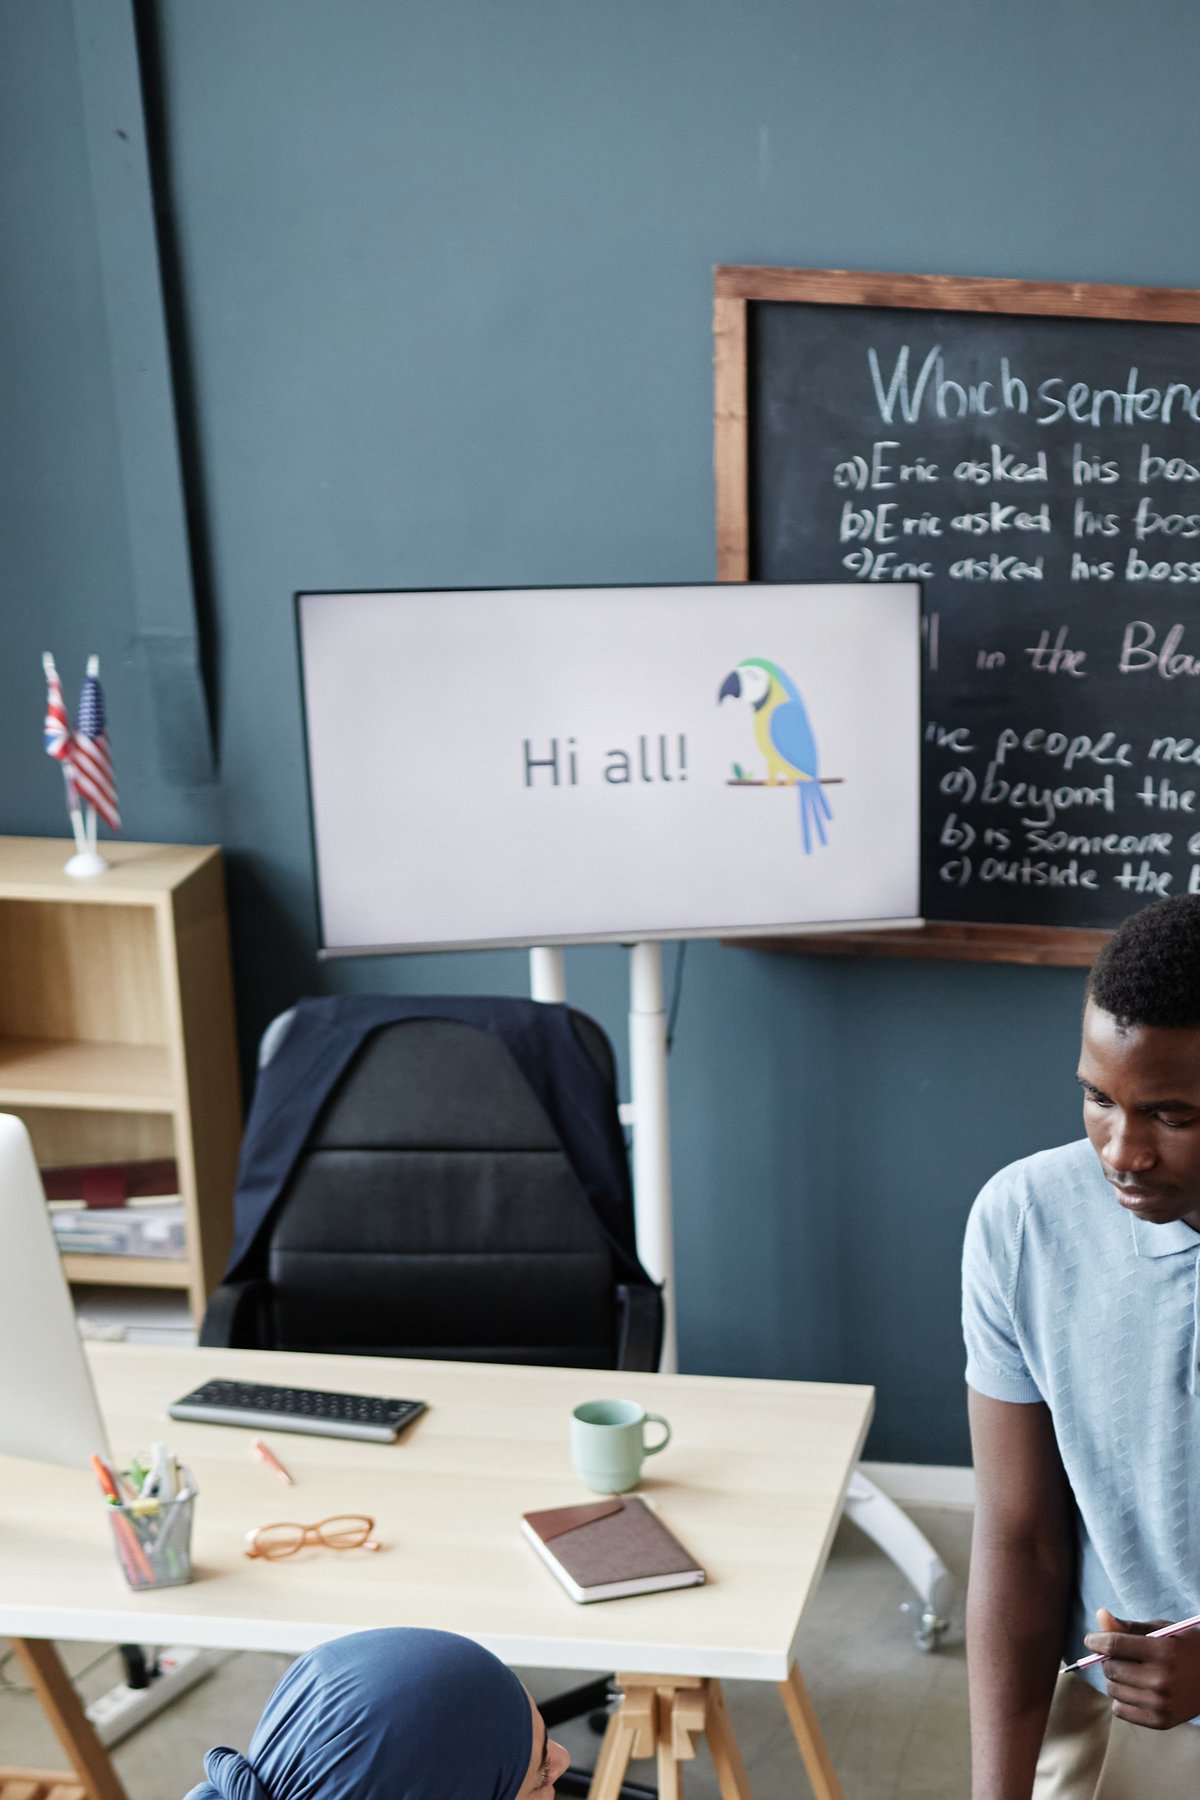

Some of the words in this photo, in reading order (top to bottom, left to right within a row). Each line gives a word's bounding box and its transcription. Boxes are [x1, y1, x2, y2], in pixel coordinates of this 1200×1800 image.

[868, 345, 1028, 424] Which
[953, 444, 1047, 485] asked
[1073, 443, 1119, 485] his
[950, 502, 1051, 535] asked
[1073, 497, 1120, 538] his
[949, 552, 1044, 581] asked
[1071, 552, 1115, 581] his
[977, 650, 1006, 669] in
[1025, 625, 1088, 677] the
[523, 737, 579, 787] Hi
[604, 733, 689, 784] all!
[997, 727, 1133, 771] people
[980, 761, 1115, 827] beyond
[1136, 774, 1196, 812] the
[979, 857, 1099, 890] outside
[1113, 860, 1173, 897] the
